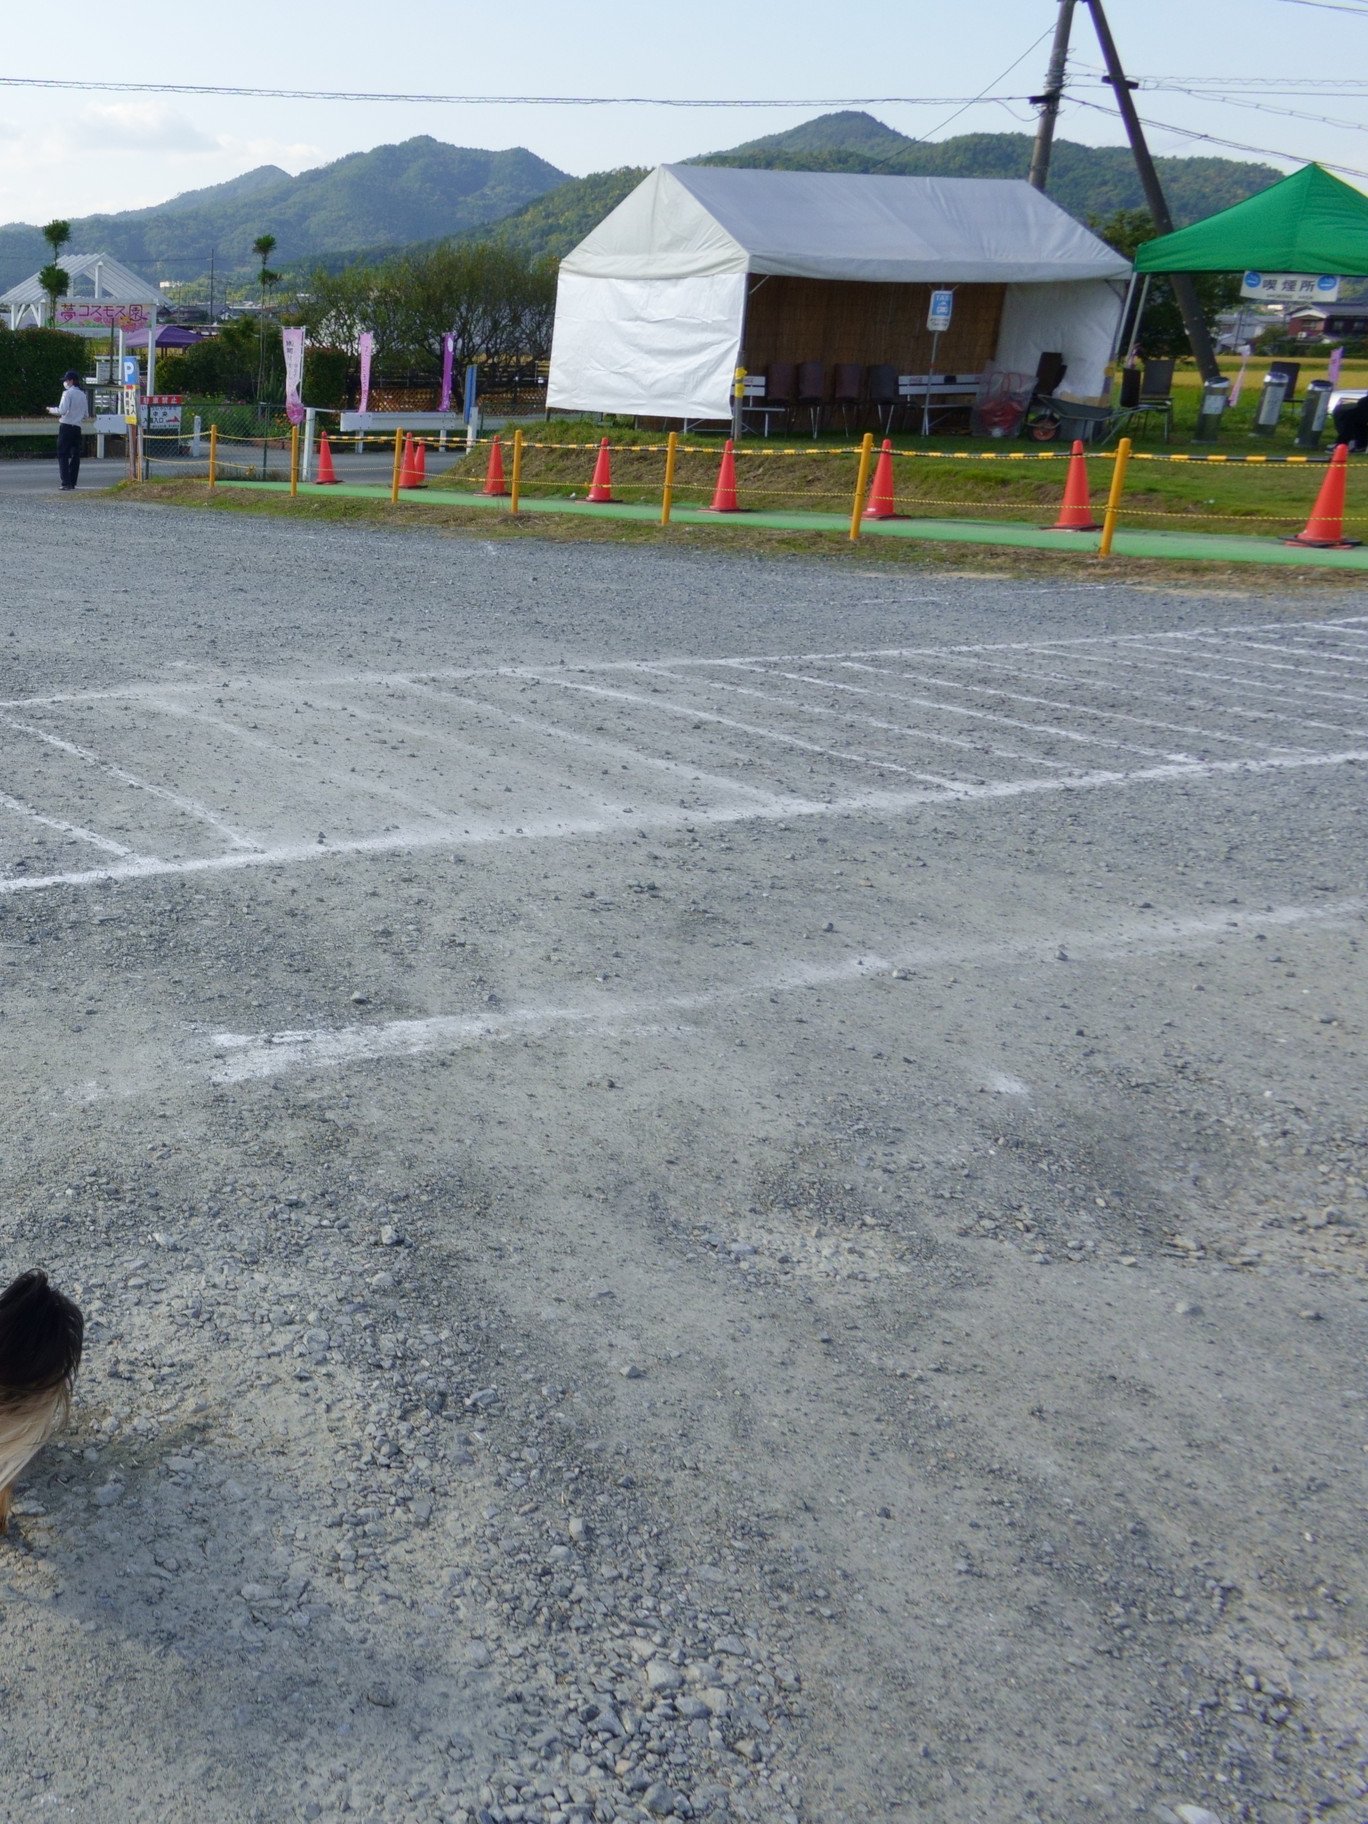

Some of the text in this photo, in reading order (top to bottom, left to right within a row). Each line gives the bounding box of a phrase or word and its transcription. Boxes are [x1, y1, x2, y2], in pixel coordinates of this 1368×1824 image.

[1262, 279, 1316, 292] 喫煙所
[59, 303, 147, 325] 夢コスモス園
[124, 361, 134, 382] P
